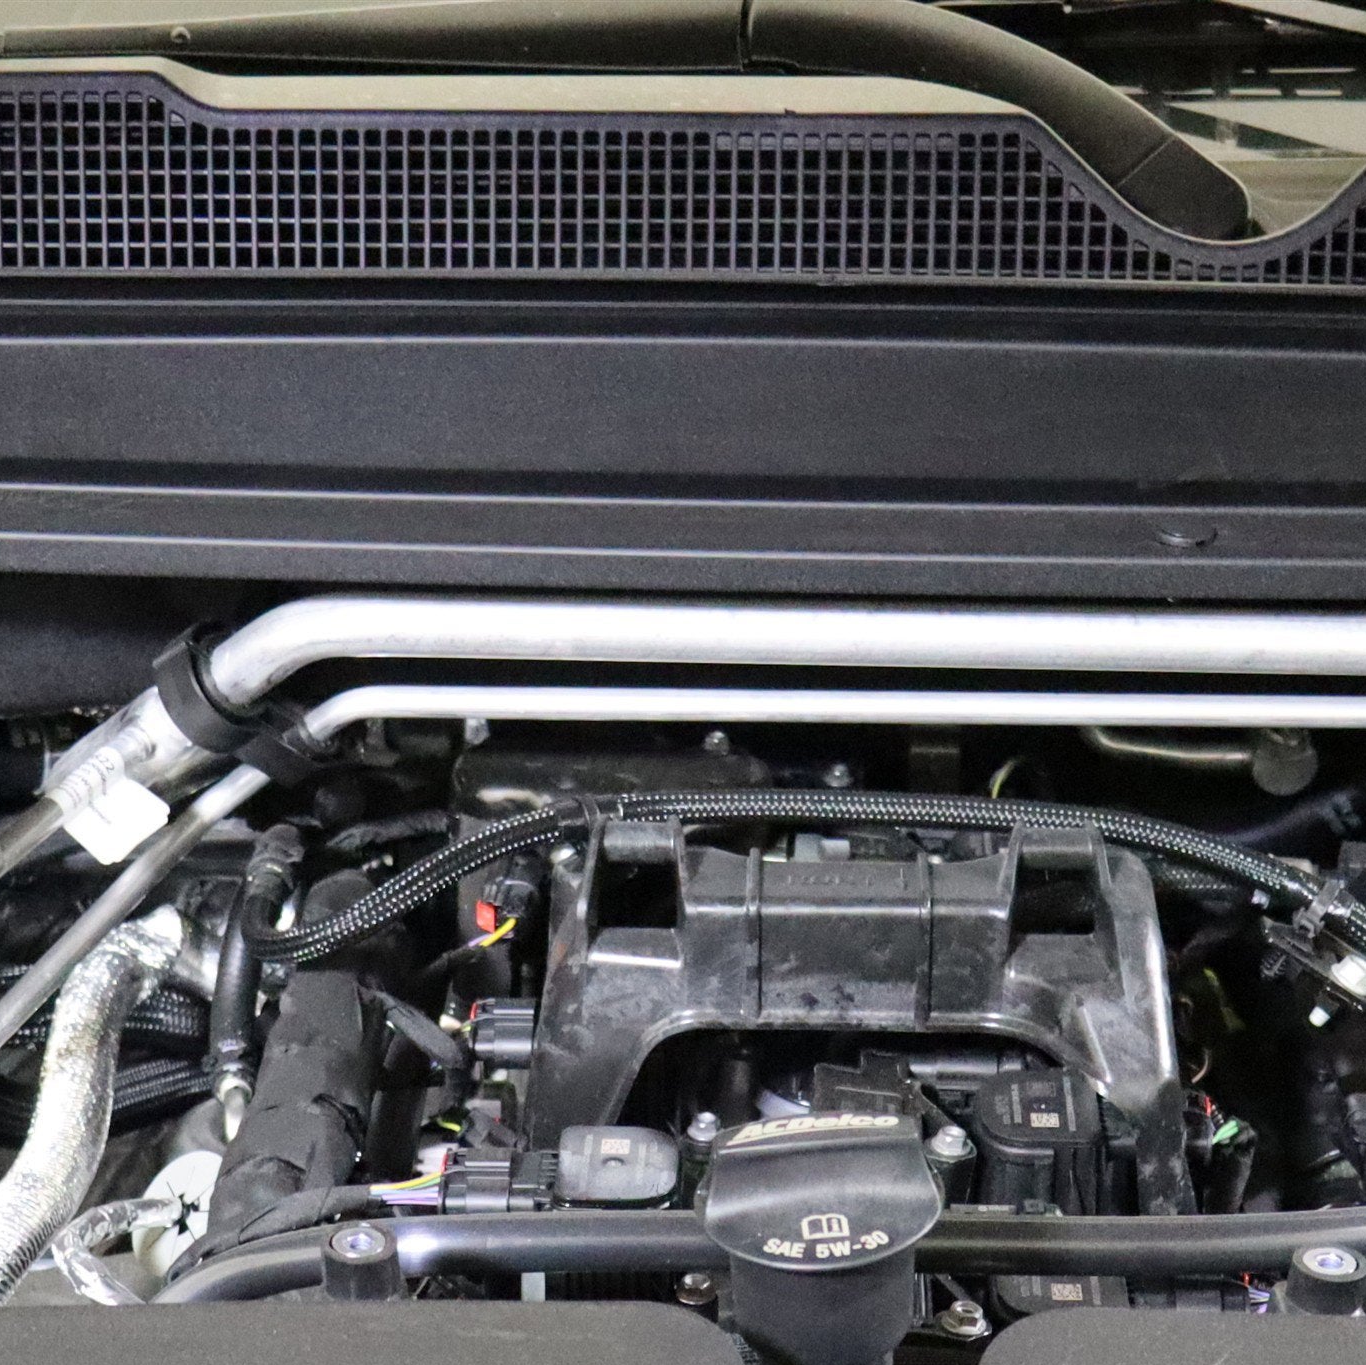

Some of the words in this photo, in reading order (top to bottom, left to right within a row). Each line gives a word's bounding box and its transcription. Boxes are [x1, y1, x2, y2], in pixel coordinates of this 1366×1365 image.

[728, 1113, 900, 1144] ACDelco
[763, 1238, 806, 1258] SAE
[815, 1230, 890, 1259] 5W-30
